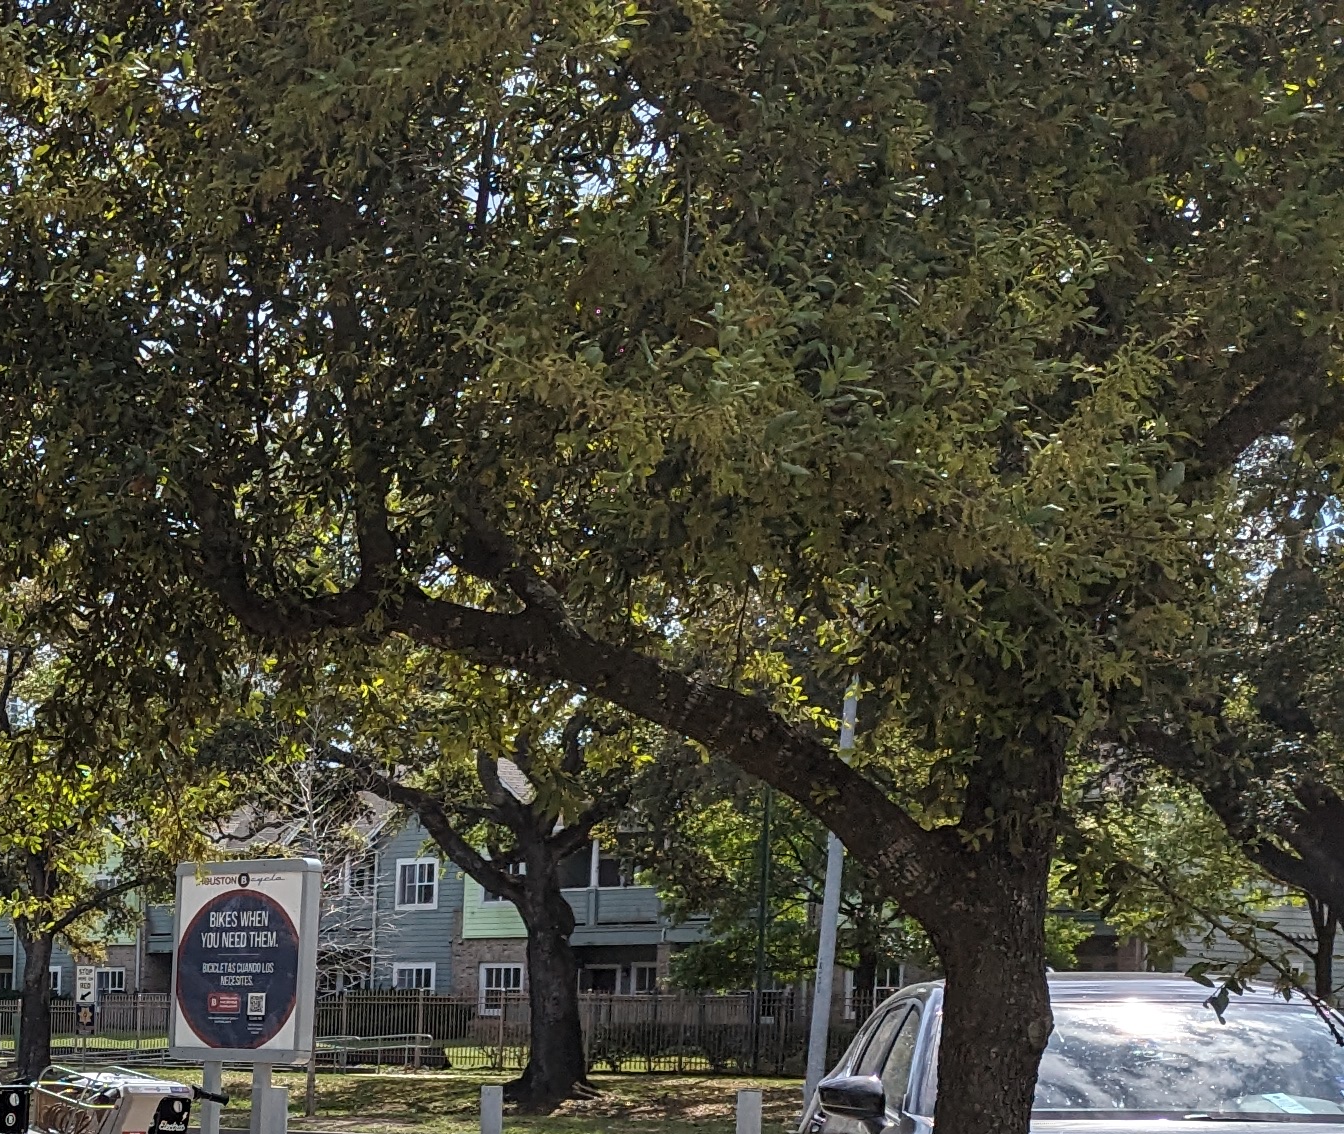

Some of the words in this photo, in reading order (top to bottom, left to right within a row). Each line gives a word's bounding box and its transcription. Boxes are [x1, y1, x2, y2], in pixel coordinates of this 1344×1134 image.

[209, 911, 239, 928] BIKES
[240, 911, 269, 927] WHEN
[201, 932, 220, 948] YOU
[221, 932, 247, 948] NEED
[249, 931, 279, 948] THEM.
[202, 963, 236, 973] BICICLETAS
[236, 963, 261, 973] CUANDO
[261, 962, 274, 973] LOS
[159, 1120, 186, 1132] Electric
